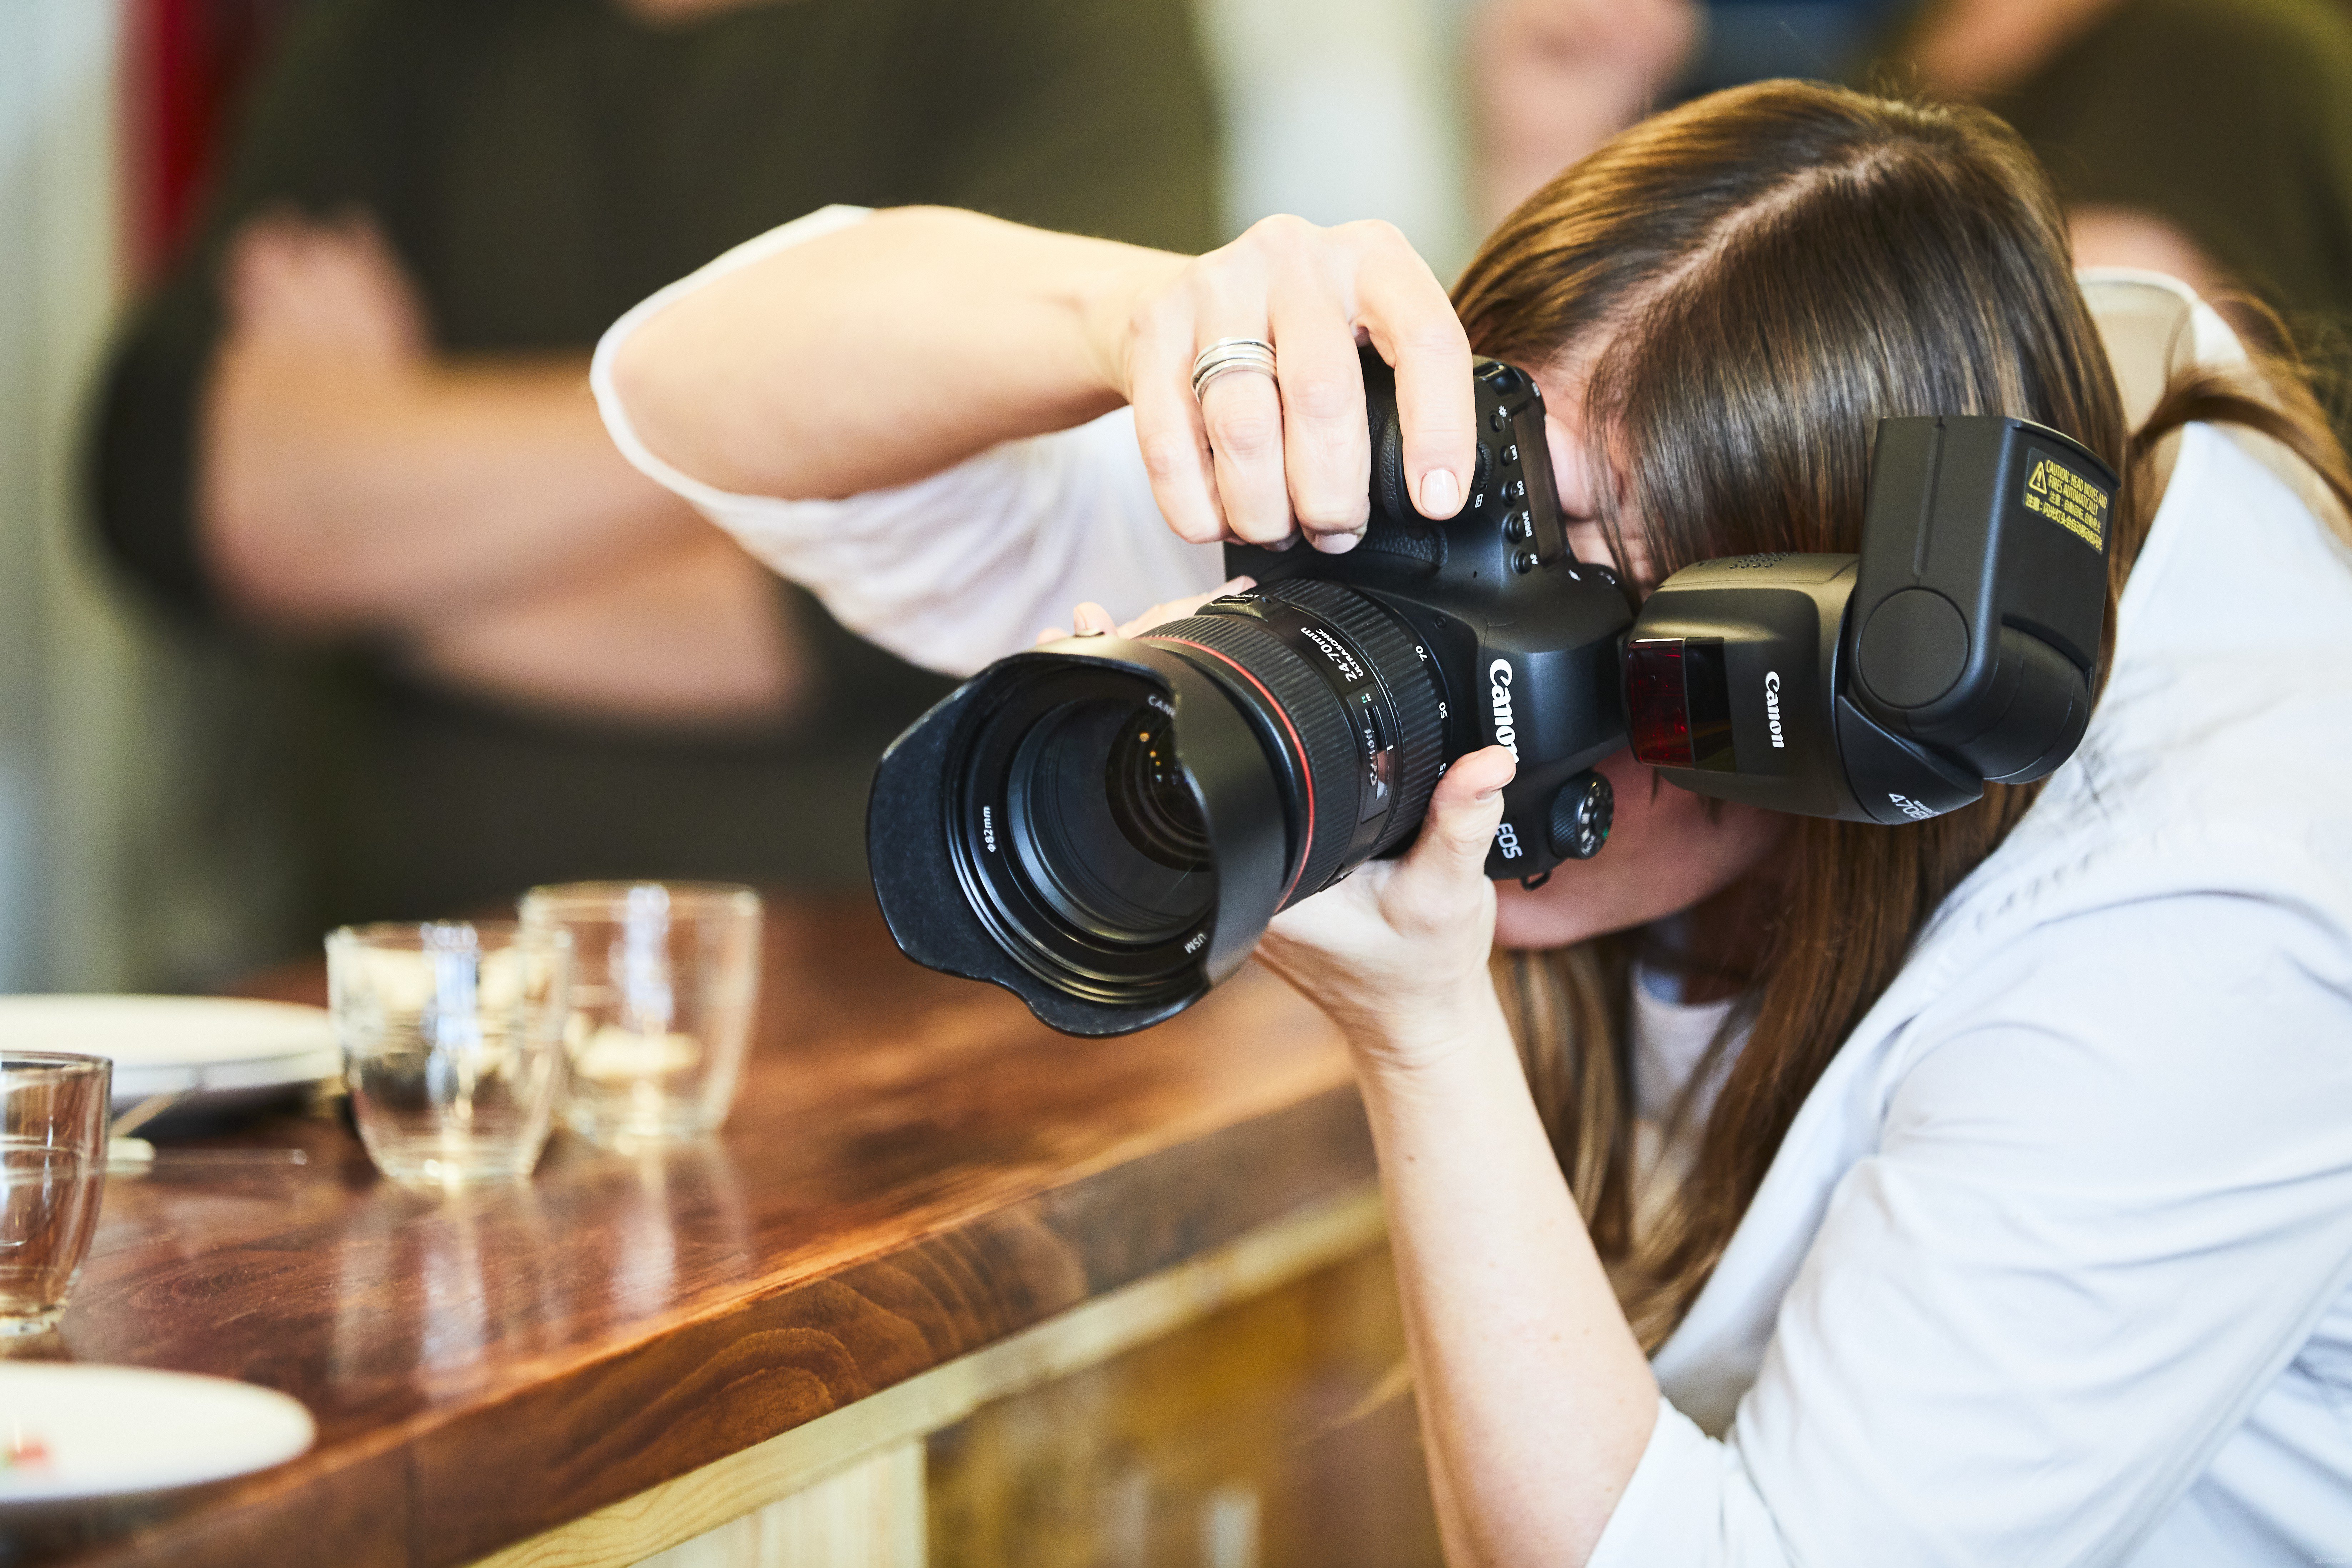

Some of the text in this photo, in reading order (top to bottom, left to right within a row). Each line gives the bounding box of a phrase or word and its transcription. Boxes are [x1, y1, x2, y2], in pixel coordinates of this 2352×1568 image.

[2045, 460, 2107, 510] CAUTION: HEAD MOVES AND
[2048, 474, 2099, 516] FIRES AUTOMATICALLY
[1301, 627, 1358, 682] 24-70mm
[1315, 628, 1364, 678] ULTRASONIC
[1415, 645, 1428, 661] 70
[1439, 701, 1448, 719] 50
[1765, 671, 1784, 748] Canon
[1497, 823, 1522, 859] EOS
[1183, 933, 1208, 954] USM
